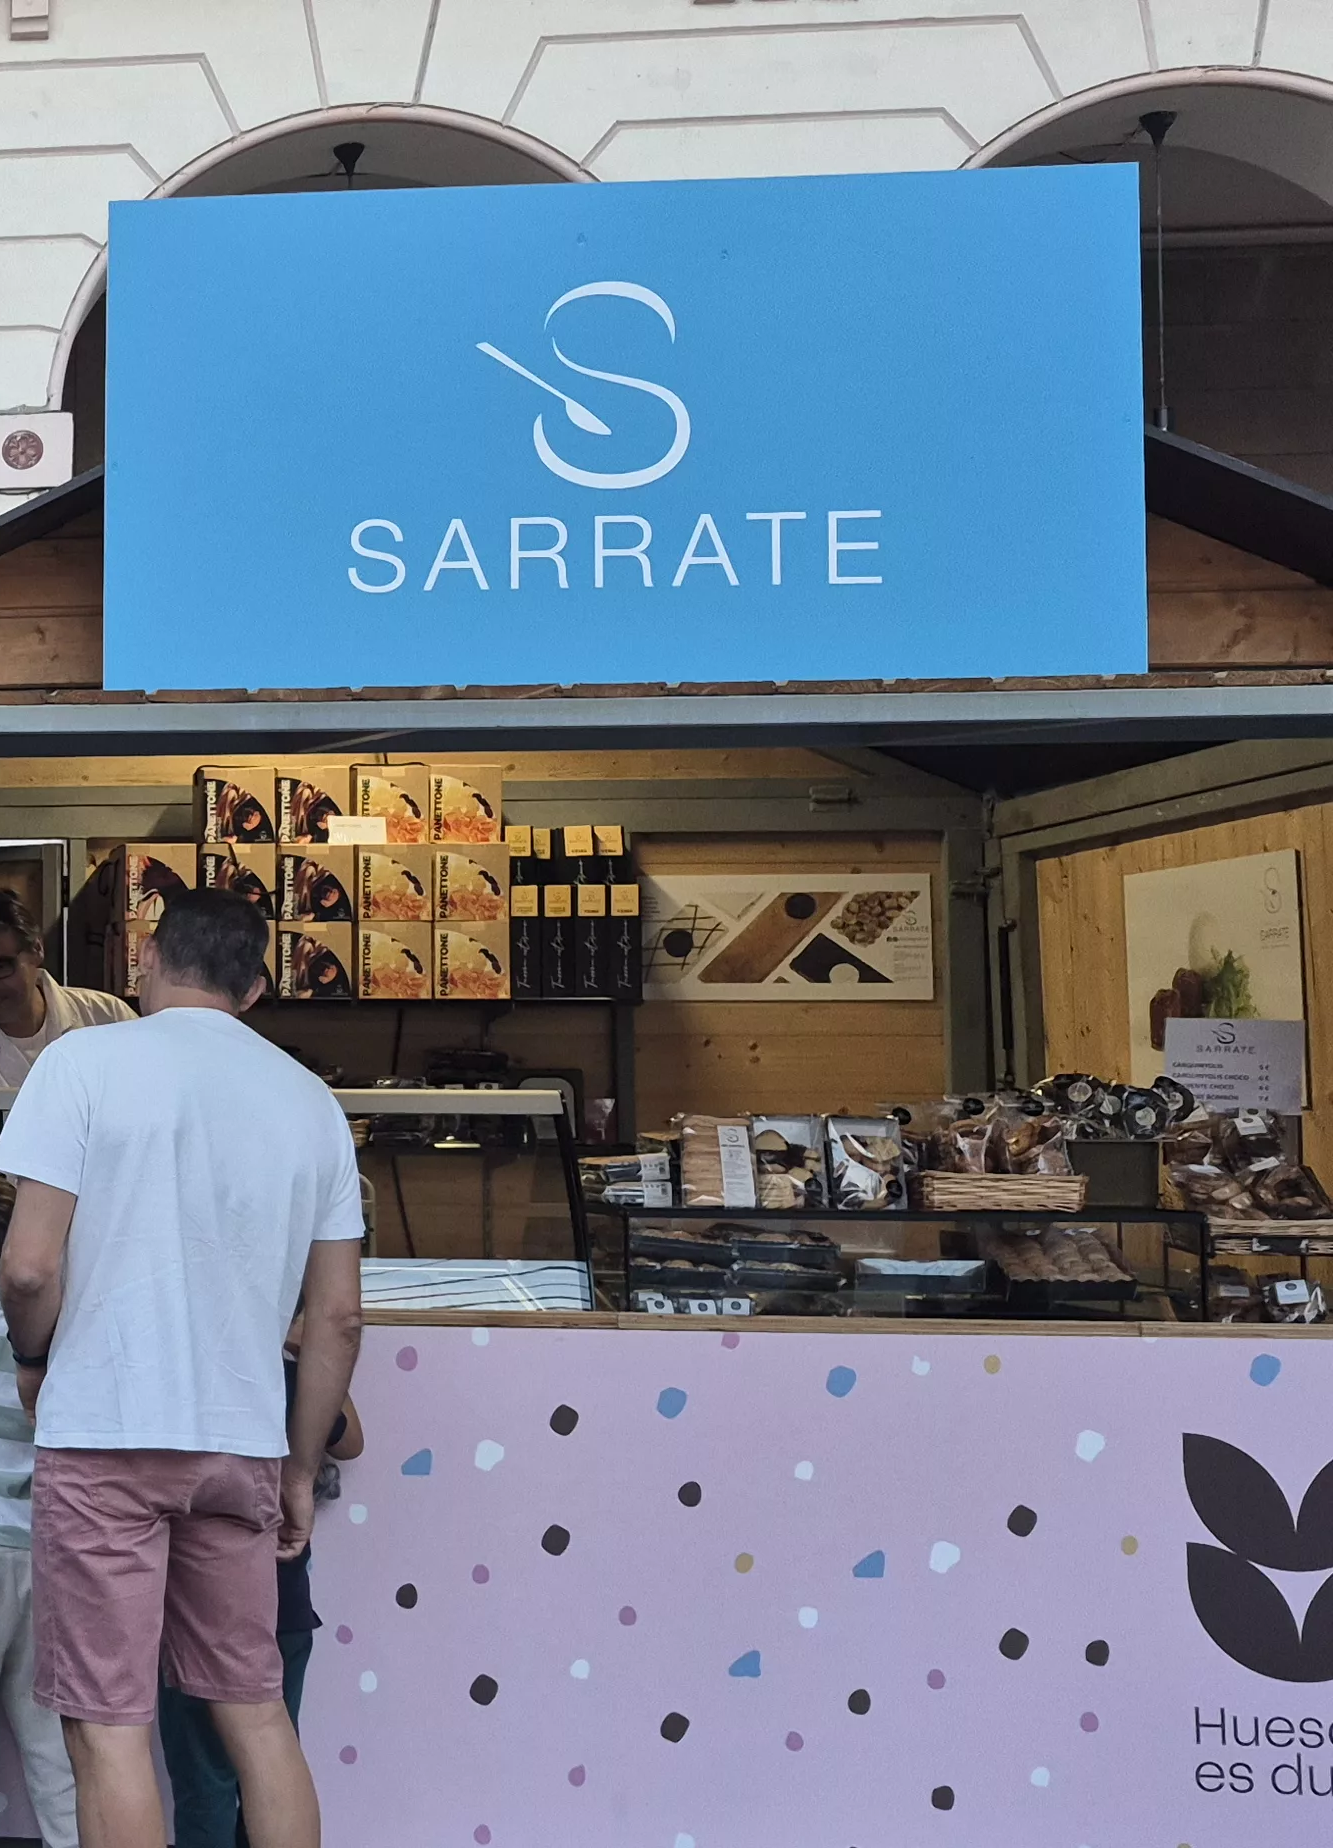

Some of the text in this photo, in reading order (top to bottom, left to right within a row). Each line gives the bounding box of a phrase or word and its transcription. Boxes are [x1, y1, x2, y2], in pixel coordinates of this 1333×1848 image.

[347, 510, 884, 593] SARRATE
[433, 778, 443, 841] PANETTONE
[362, 855, 372, 919] PANETTONE
[439, 855, 449, 919] PANETTONE
[362, 933, 372, 997] PANETTONE
[439, 932, 449, 997] PANETTONE
[1195, 1044, 1256, 1055] SARRATE
[1194, 1706, 1333, 1749] Hues
[1195, 1761, 1255, 1794] es
